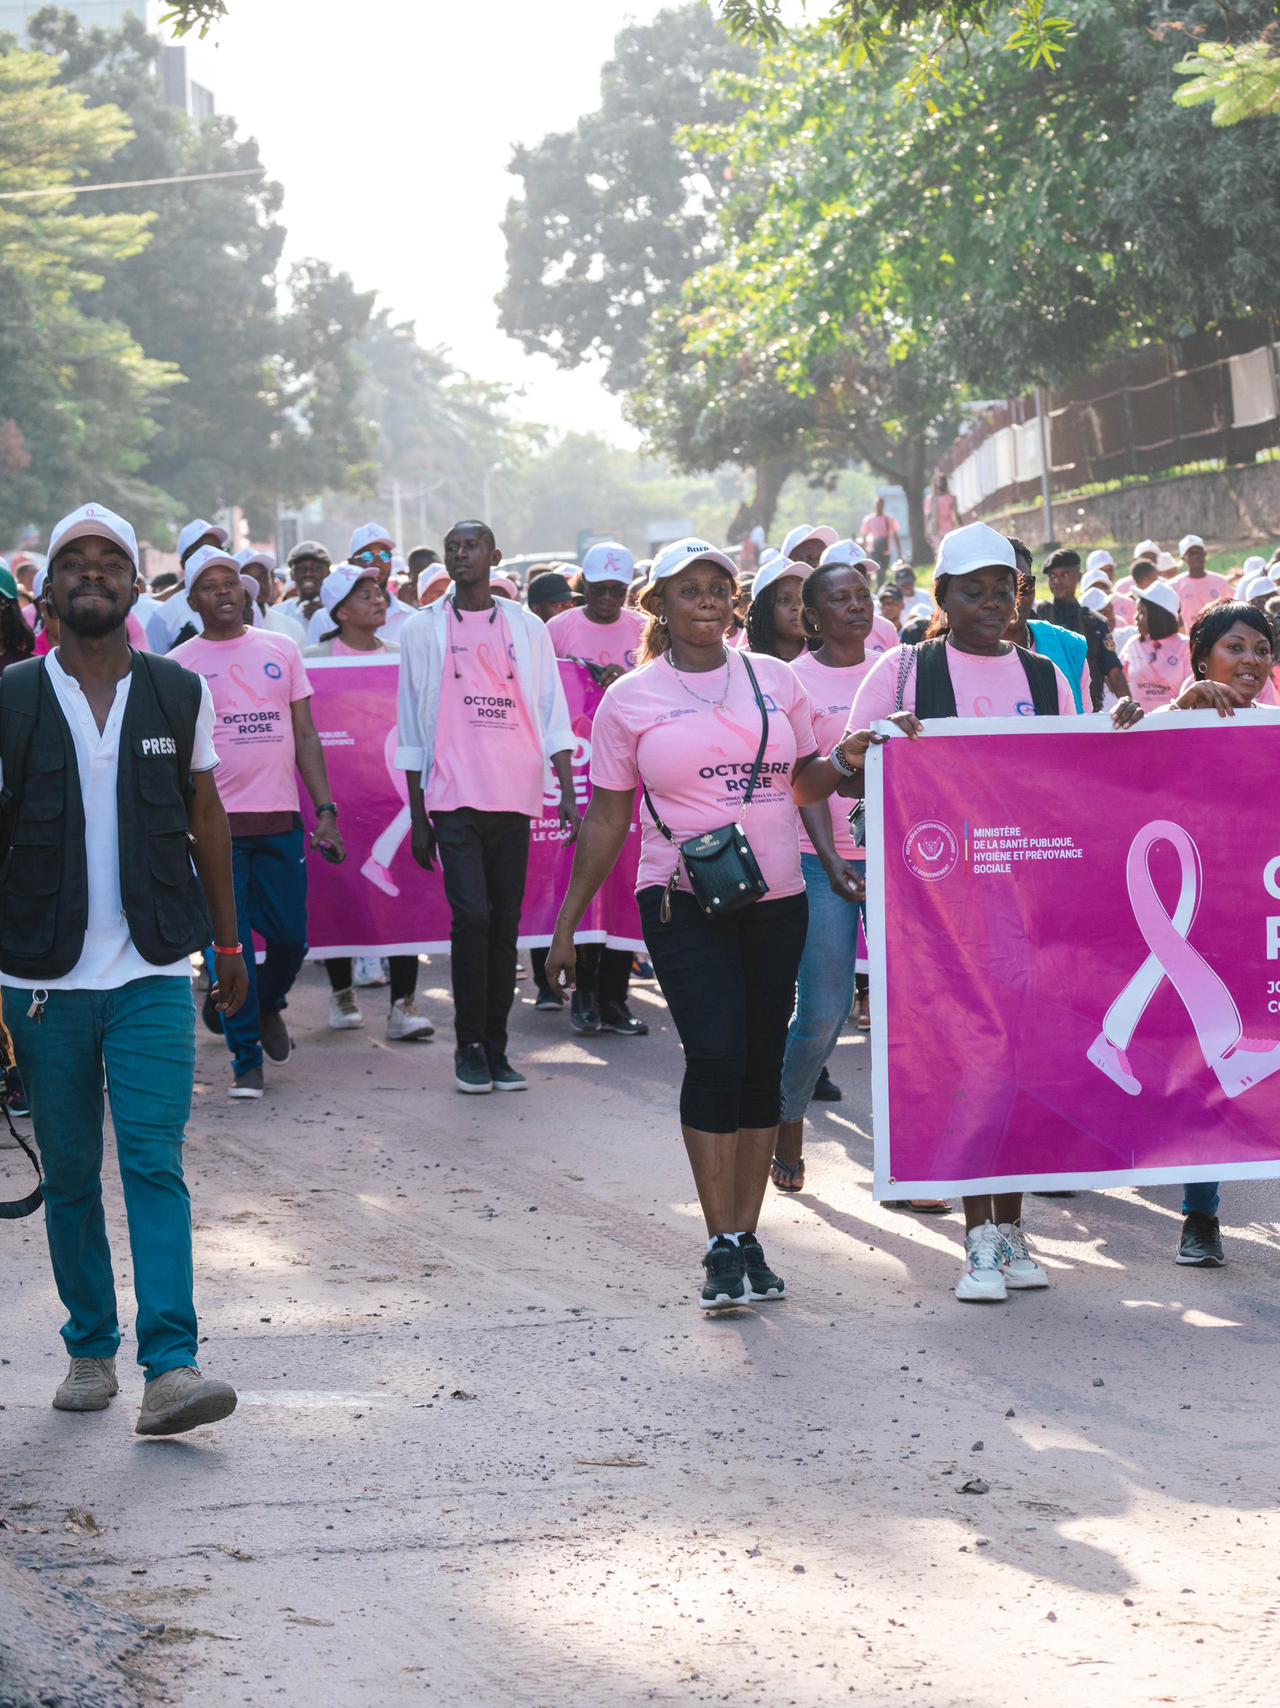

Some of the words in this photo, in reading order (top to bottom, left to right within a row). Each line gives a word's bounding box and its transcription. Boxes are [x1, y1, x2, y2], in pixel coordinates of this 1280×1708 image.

[223, 712, 281, 724] OCTOBRE
[478, 708, 507, 719] ROSE
[239, 723, 273, 734] ROSE
[142, 737, 176, 755] PRESS
[699, 762, 790, 779] OCTOBRE
[725, 777, 772, 791] ROSE
[973, 826, 1021, 837] MINISTÈRE
[973, 840, 985, 850] DE
[987, 840, 999, 849] LA
[1000, 837, 1029, 849] SANTÉ
[1030, 837, 1075, 848] PUBLIQUE,
[974, 849, 1012, 861] HYGIÈNE
[1013, 851, 1024, 860] ET
[1026, 848, 1083, 860] PRÉVOYANCE
[974, 864, 1011, 874] SOCIALE
